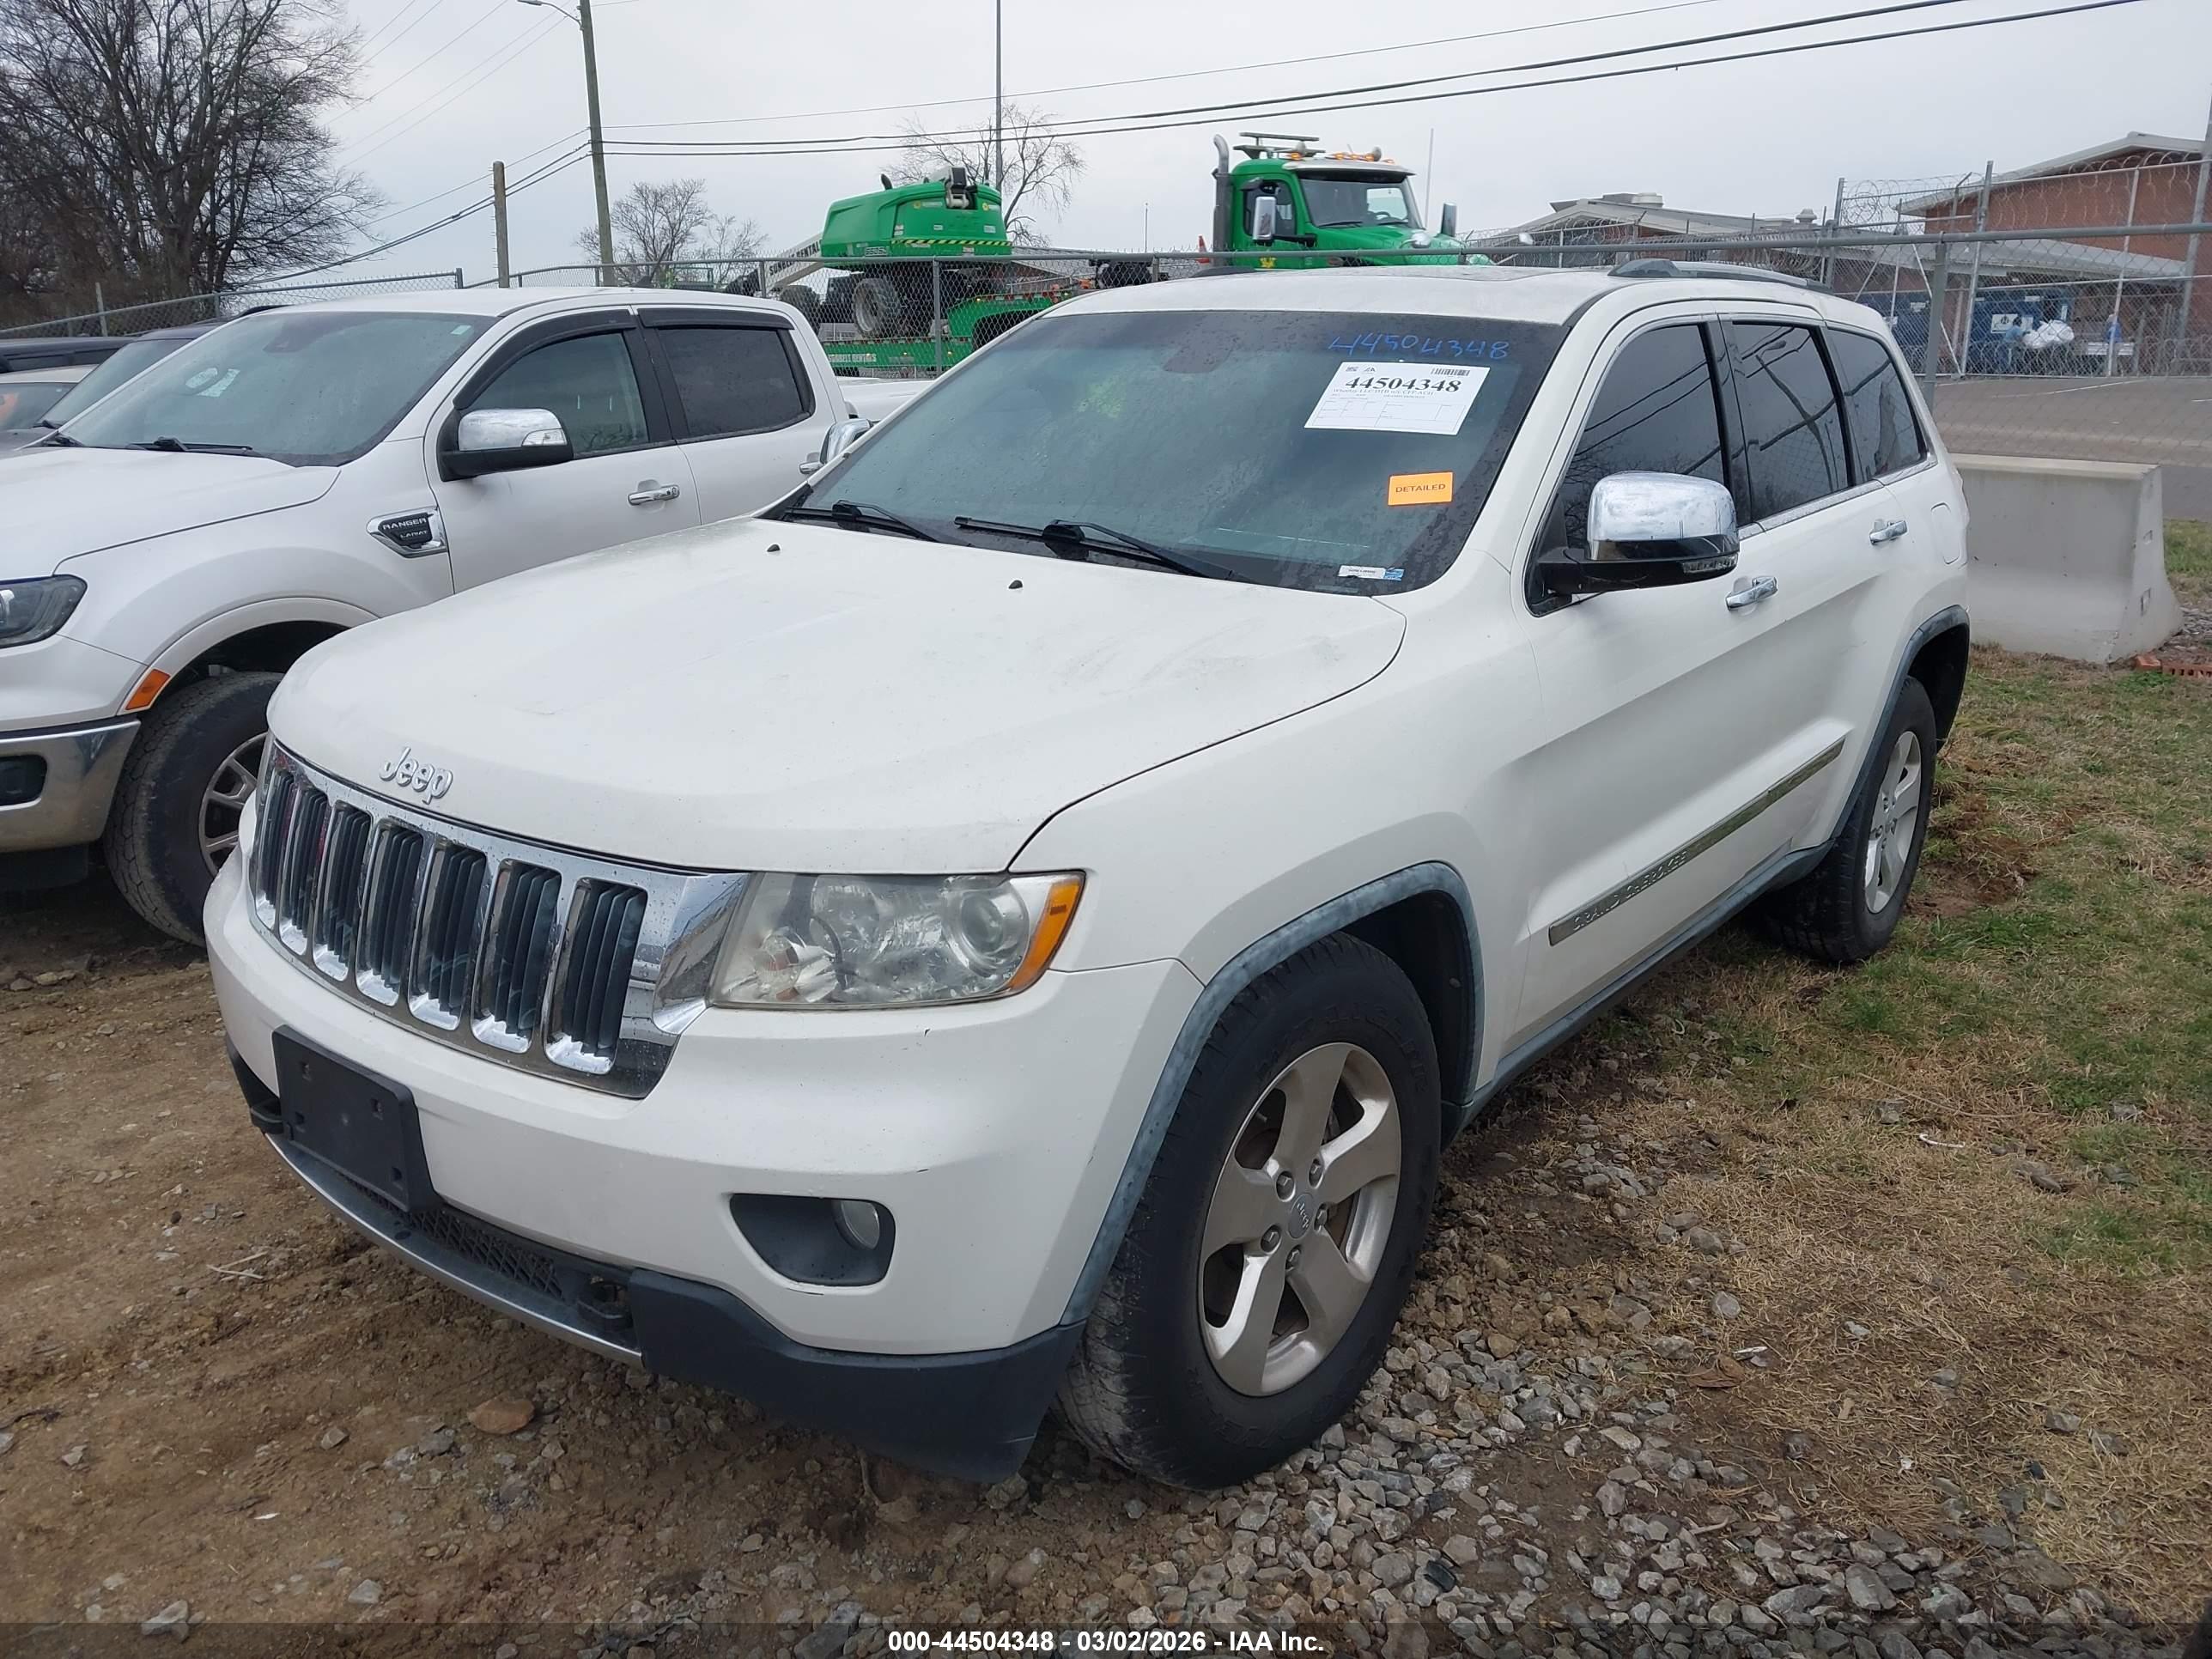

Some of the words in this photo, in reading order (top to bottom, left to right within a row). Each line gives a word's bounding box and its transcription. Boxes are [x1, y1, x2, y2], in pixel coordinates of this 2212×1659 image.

[1328, 332, 1510, 359] 44504348
[1345, 376, 1462, 392] 44504348
[1395, 483, 1446, 493] DETAILED
[382, 517, 427, 531] RANGER
[400, 530, 428, 538] LARIAT
[379, 746, 453, 805] Jeep
